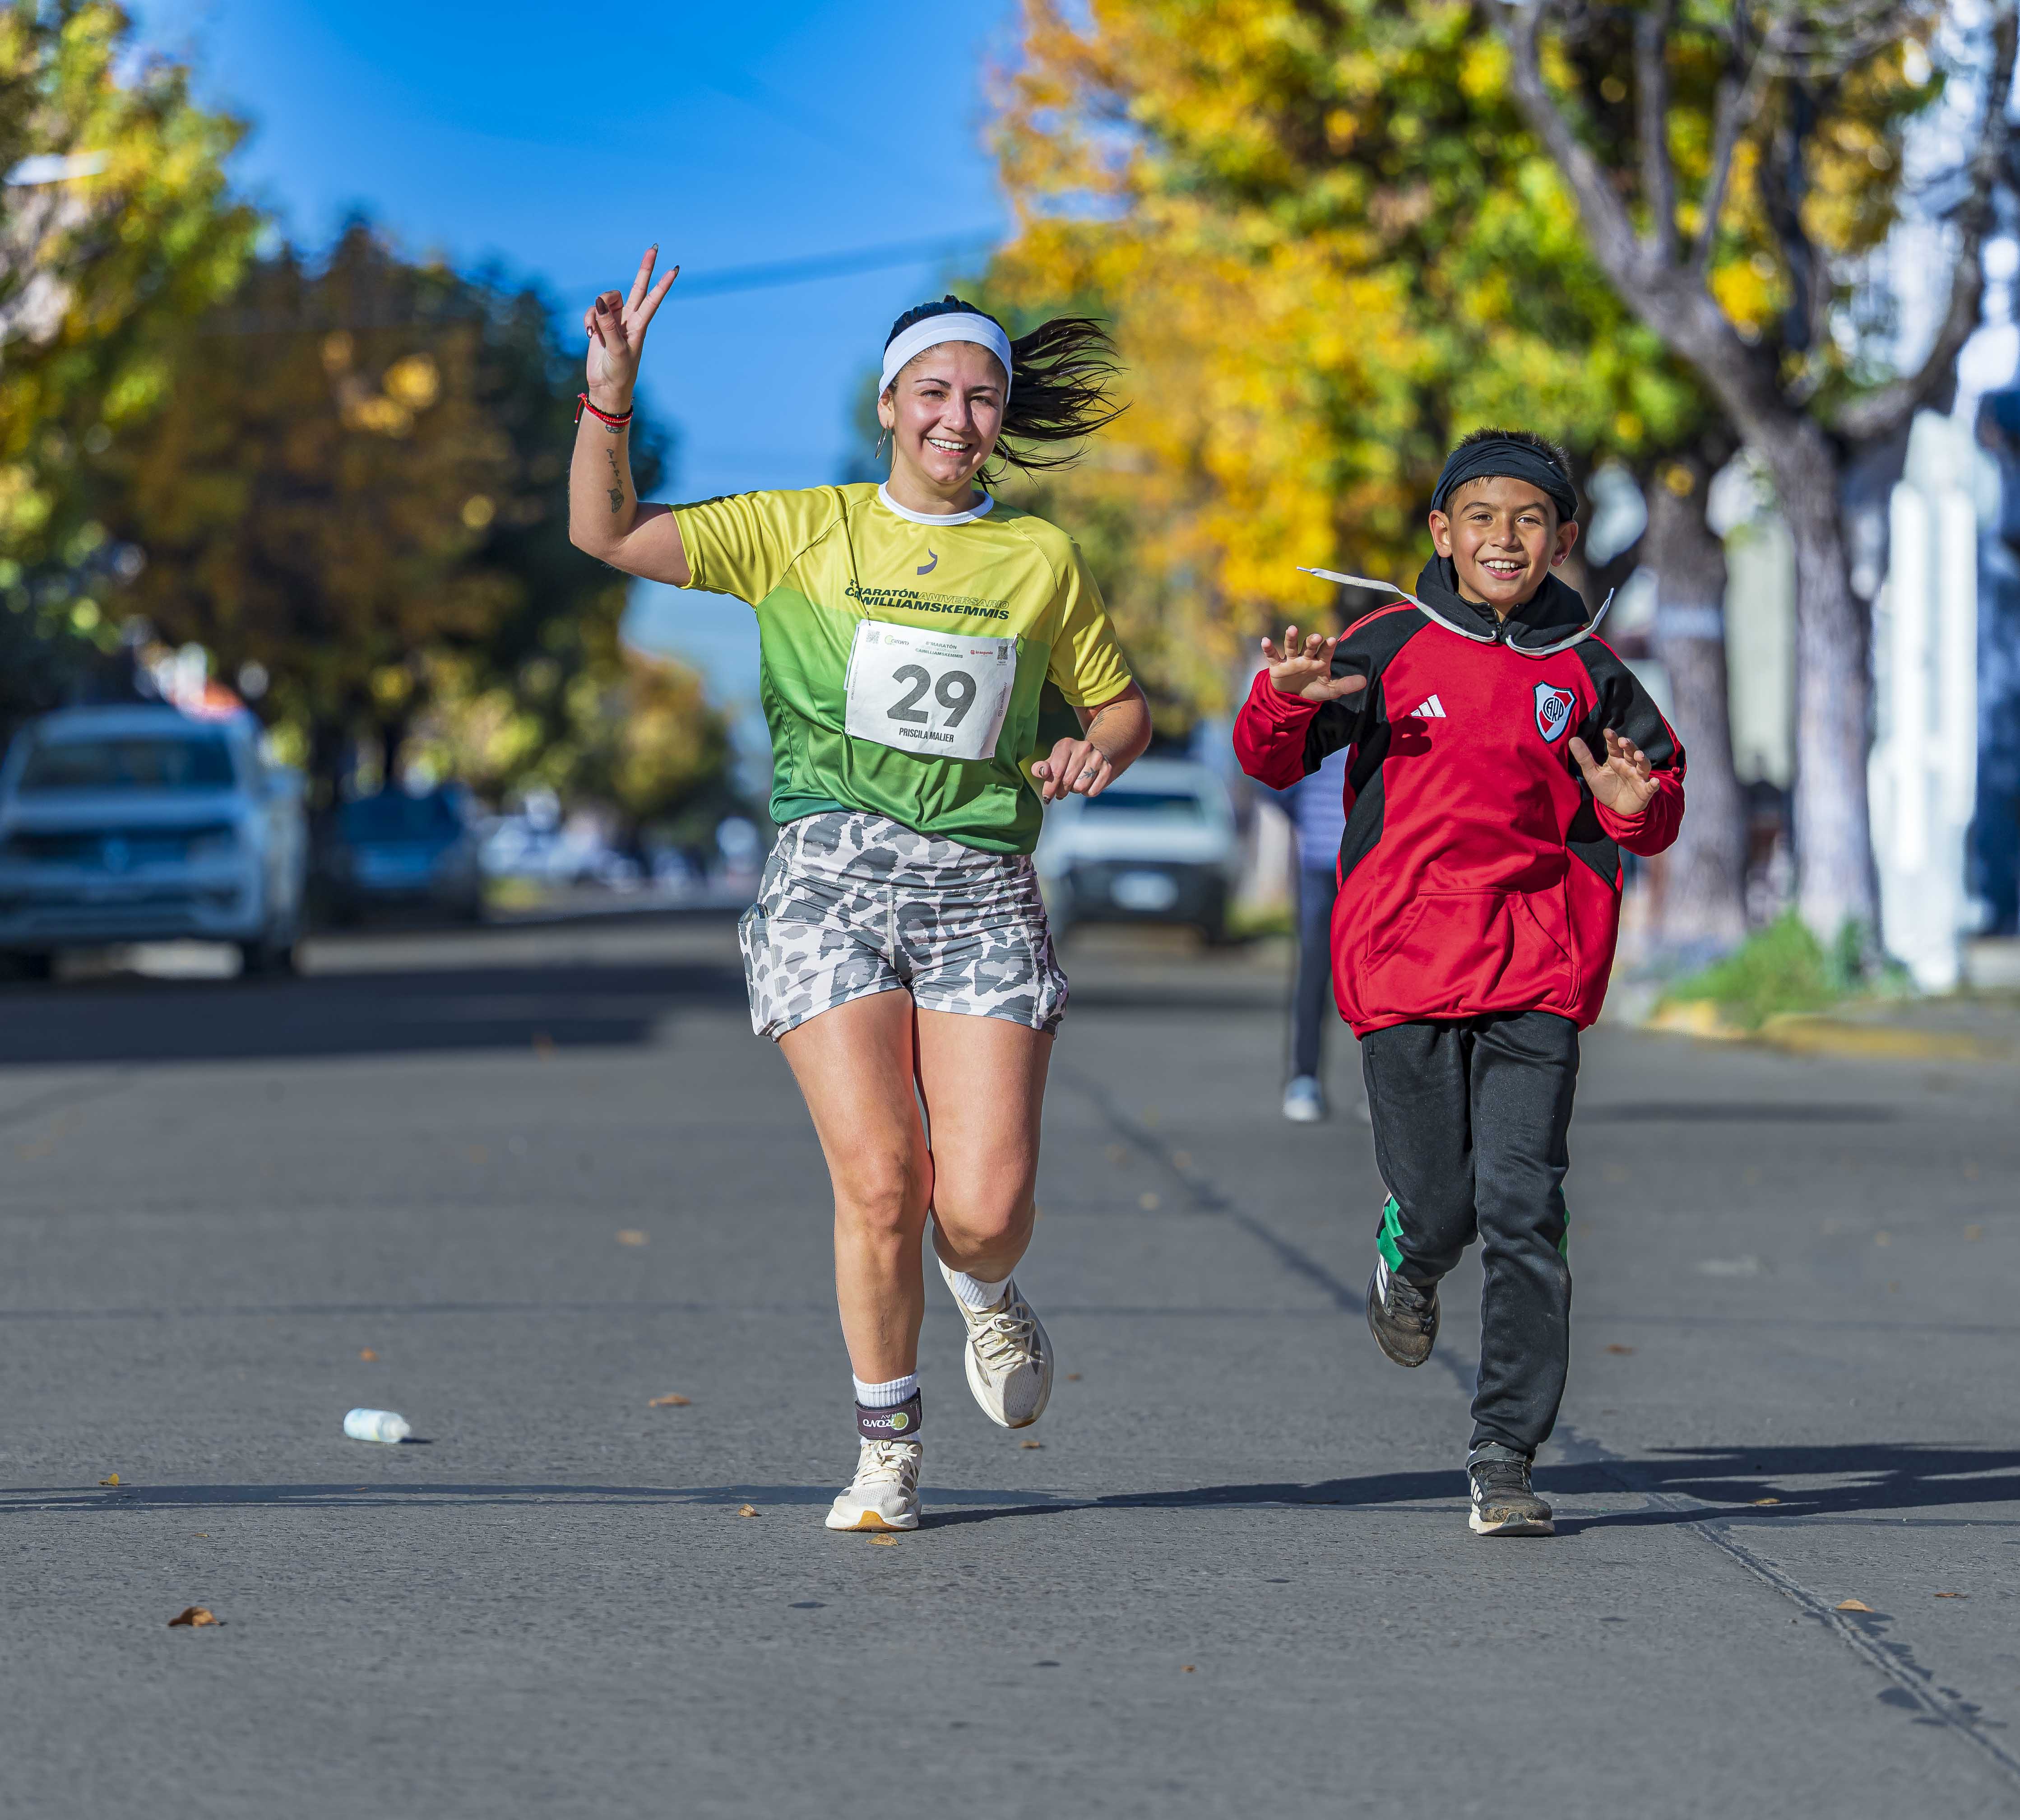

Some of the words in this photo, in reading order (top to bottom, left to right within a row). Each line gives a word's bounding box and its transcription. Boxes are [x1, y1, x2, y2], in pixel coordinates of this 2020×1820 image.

[887, 664, 976, 728] 29
[899, 727, 928, 739] PRISCILA
[929, 731, 954, 743] MALIER
